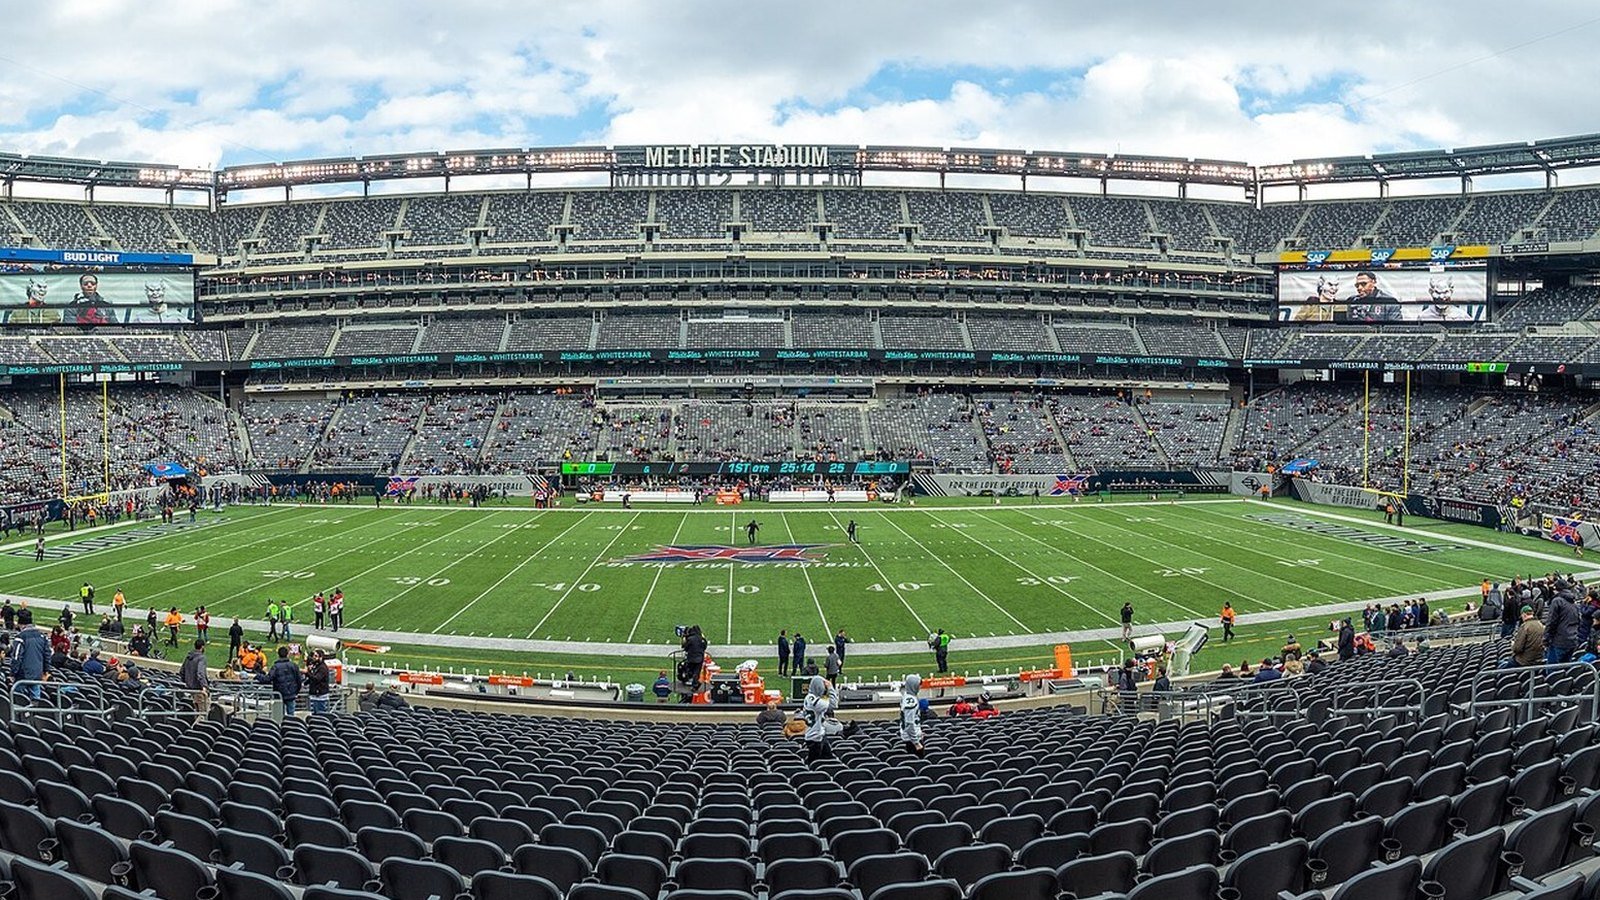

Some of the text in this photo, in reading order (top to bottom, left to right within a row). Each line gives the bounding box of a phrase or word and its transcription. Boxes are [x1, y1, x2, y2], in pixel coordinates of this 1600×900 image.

[645, 146, 829, 168] METLIFE STADIUM
[64, 252, 120, 263] BUD LIGHT
[1307, 253, 1326, 263] SAP
[1371, 251, 1390, 261] SAP
[1431, 250, 1450, 260] SAP
[1489, 363, 1496, 372] 0
[588, 464, 596, 473] 0
[728, 463, 750, 472] 1ST
[780, 463, 816, 472] 25:14
[829, 463, 845, 472] 25
[889, 463, 897, 472] 0
[949, 481, 1047, 489] FOR THE LOVE OF FOOTBALL
[1320, 487, 1361, 497] FOR THE LOVE
[396, 577, 451, 586] 30
[1016, 576, 1070, 585] 30
[545, 583, 602, 592] 40
[703, 585, 760, 594] 50
[866, 582, 921, 592] 40
[744, 689, 756, 704] G
